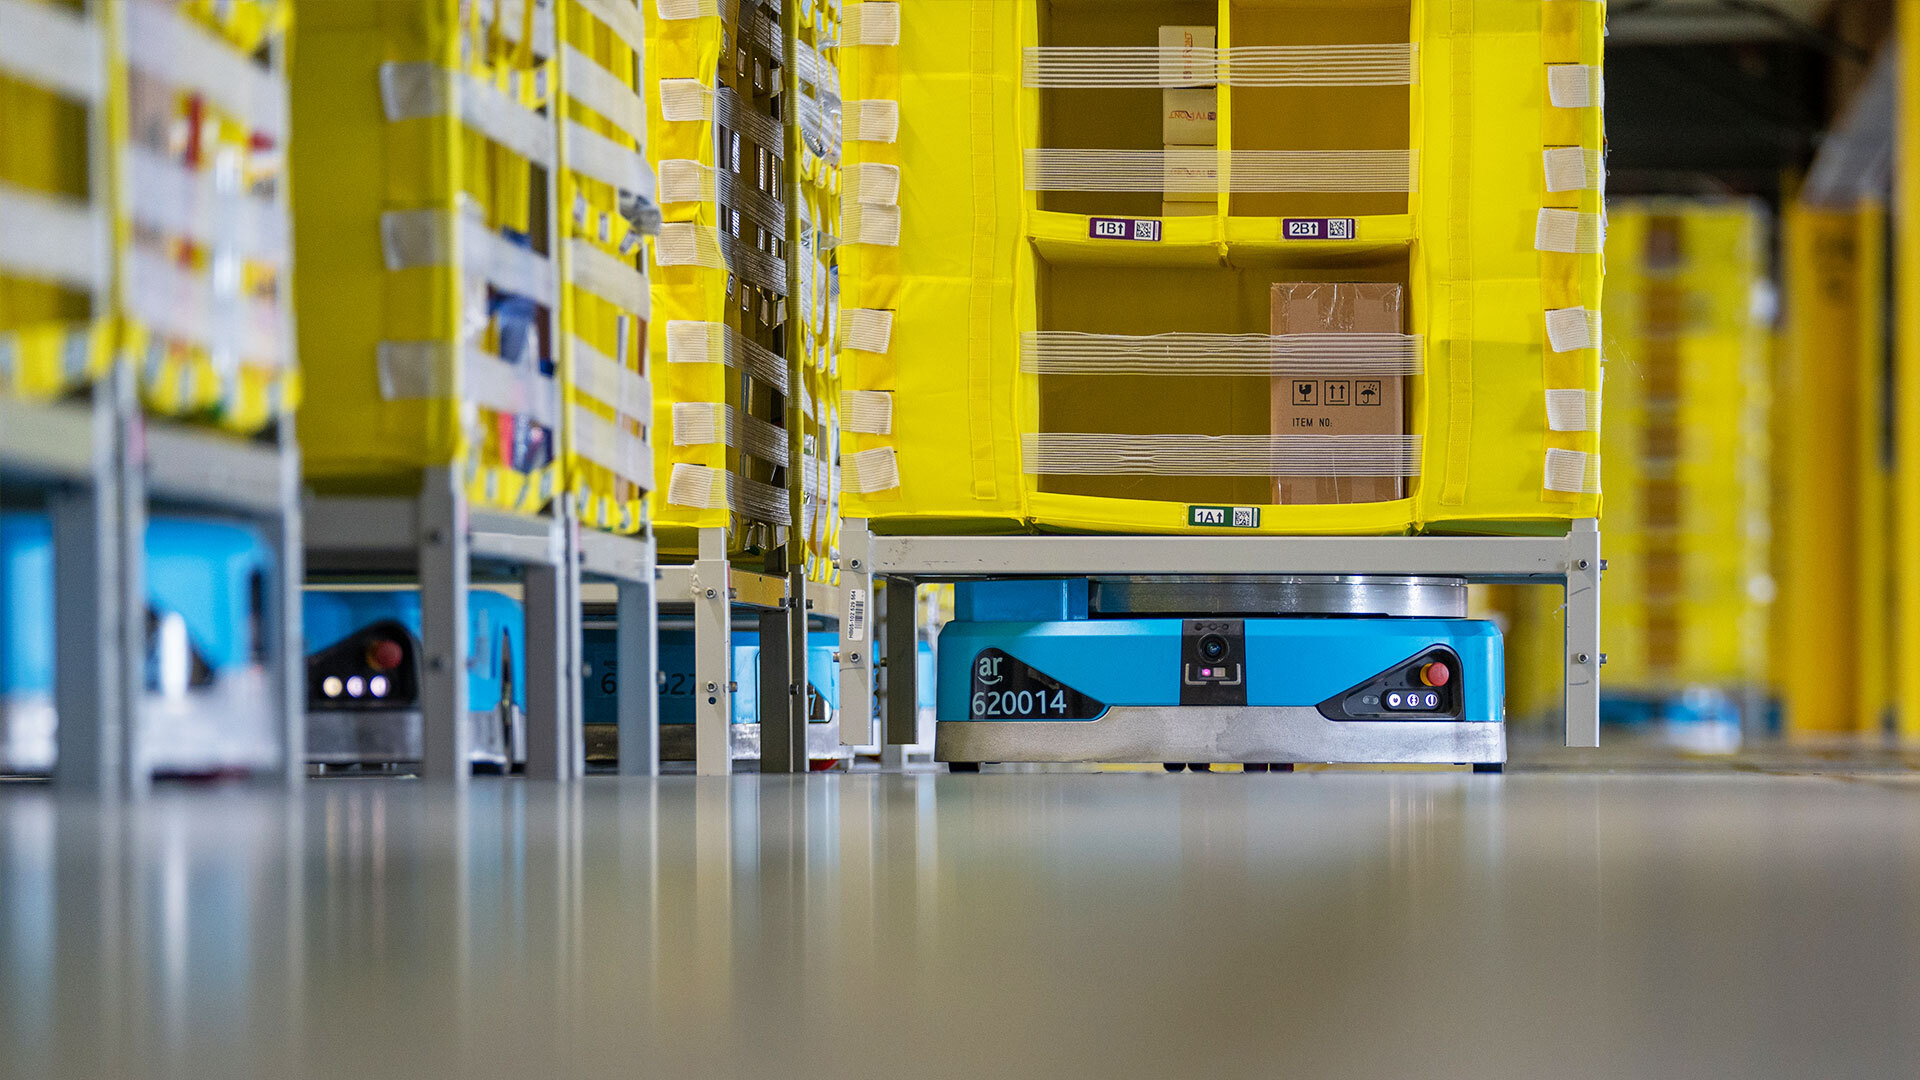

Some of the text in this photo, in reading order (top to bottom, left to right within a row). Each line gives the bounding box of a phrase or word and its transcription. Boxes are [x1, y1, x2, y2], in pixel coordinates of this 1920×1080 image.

[1099, 223, 1116, 234] 1B
[1292, 223, 1310, 234] 2B
[1292, 417, 1333, 427] ITEM NO:
[1197, 511, 1215, 523] 1A
[978, 656, 1004, 677] ar
[971, 690, 1068, 716] 620014
